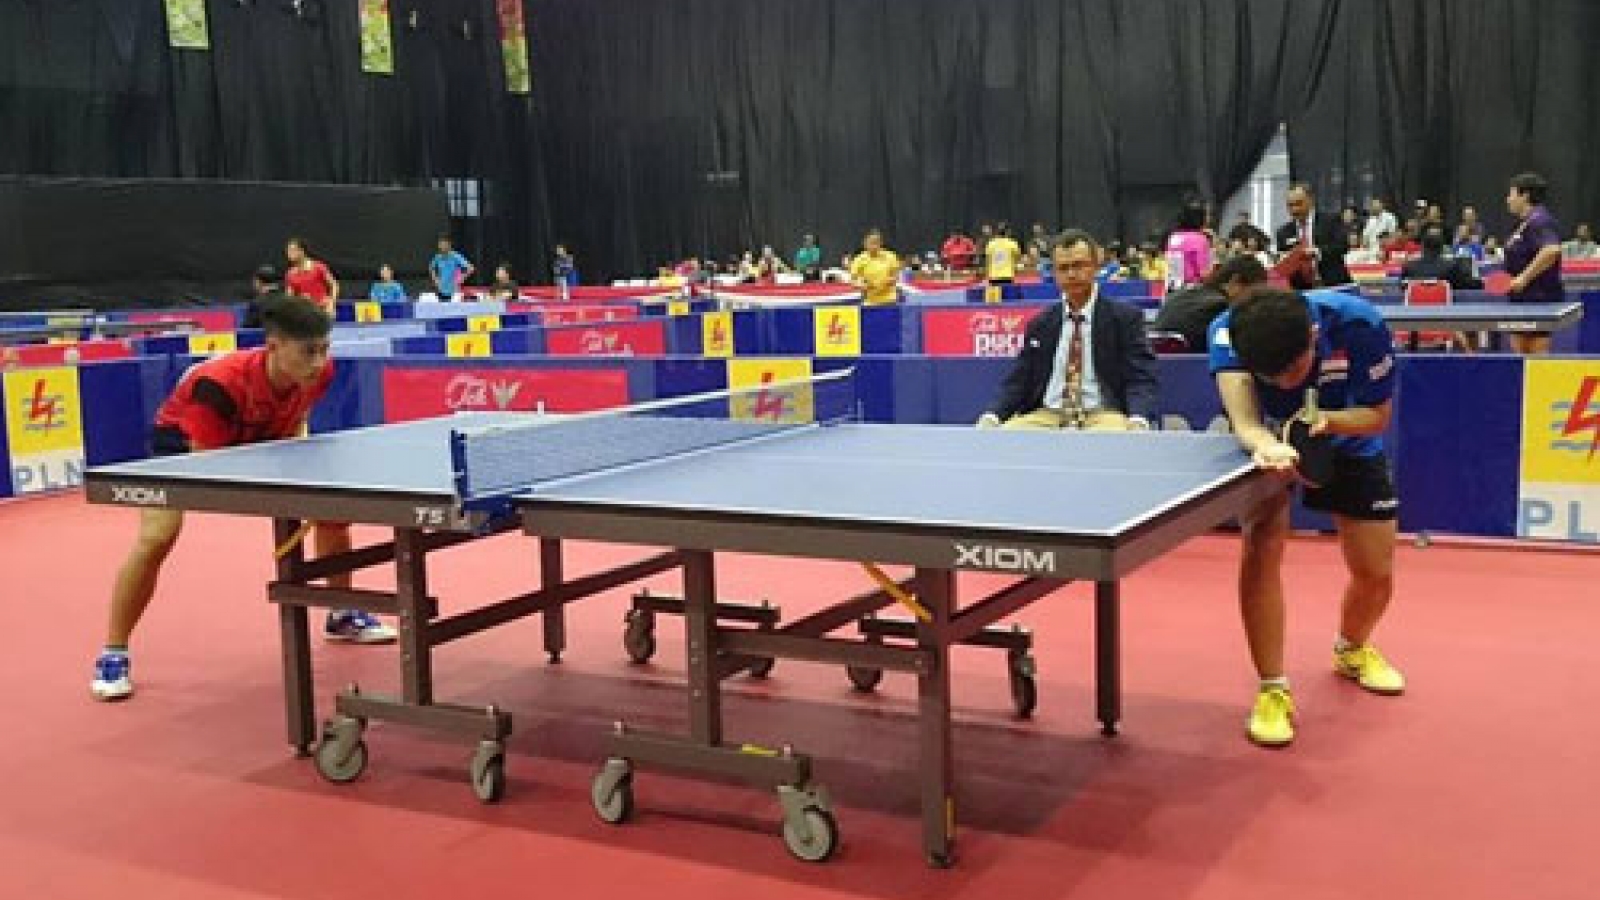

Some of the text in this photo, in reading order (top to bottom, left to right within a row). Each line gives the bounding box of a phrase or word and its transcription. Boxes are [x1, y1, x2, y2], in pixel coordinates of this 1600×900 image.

[15, 458, 84, 495] PLN
[111, 485, 167, 504] XIOM
[955, 544, 1055, 572] XIOM
